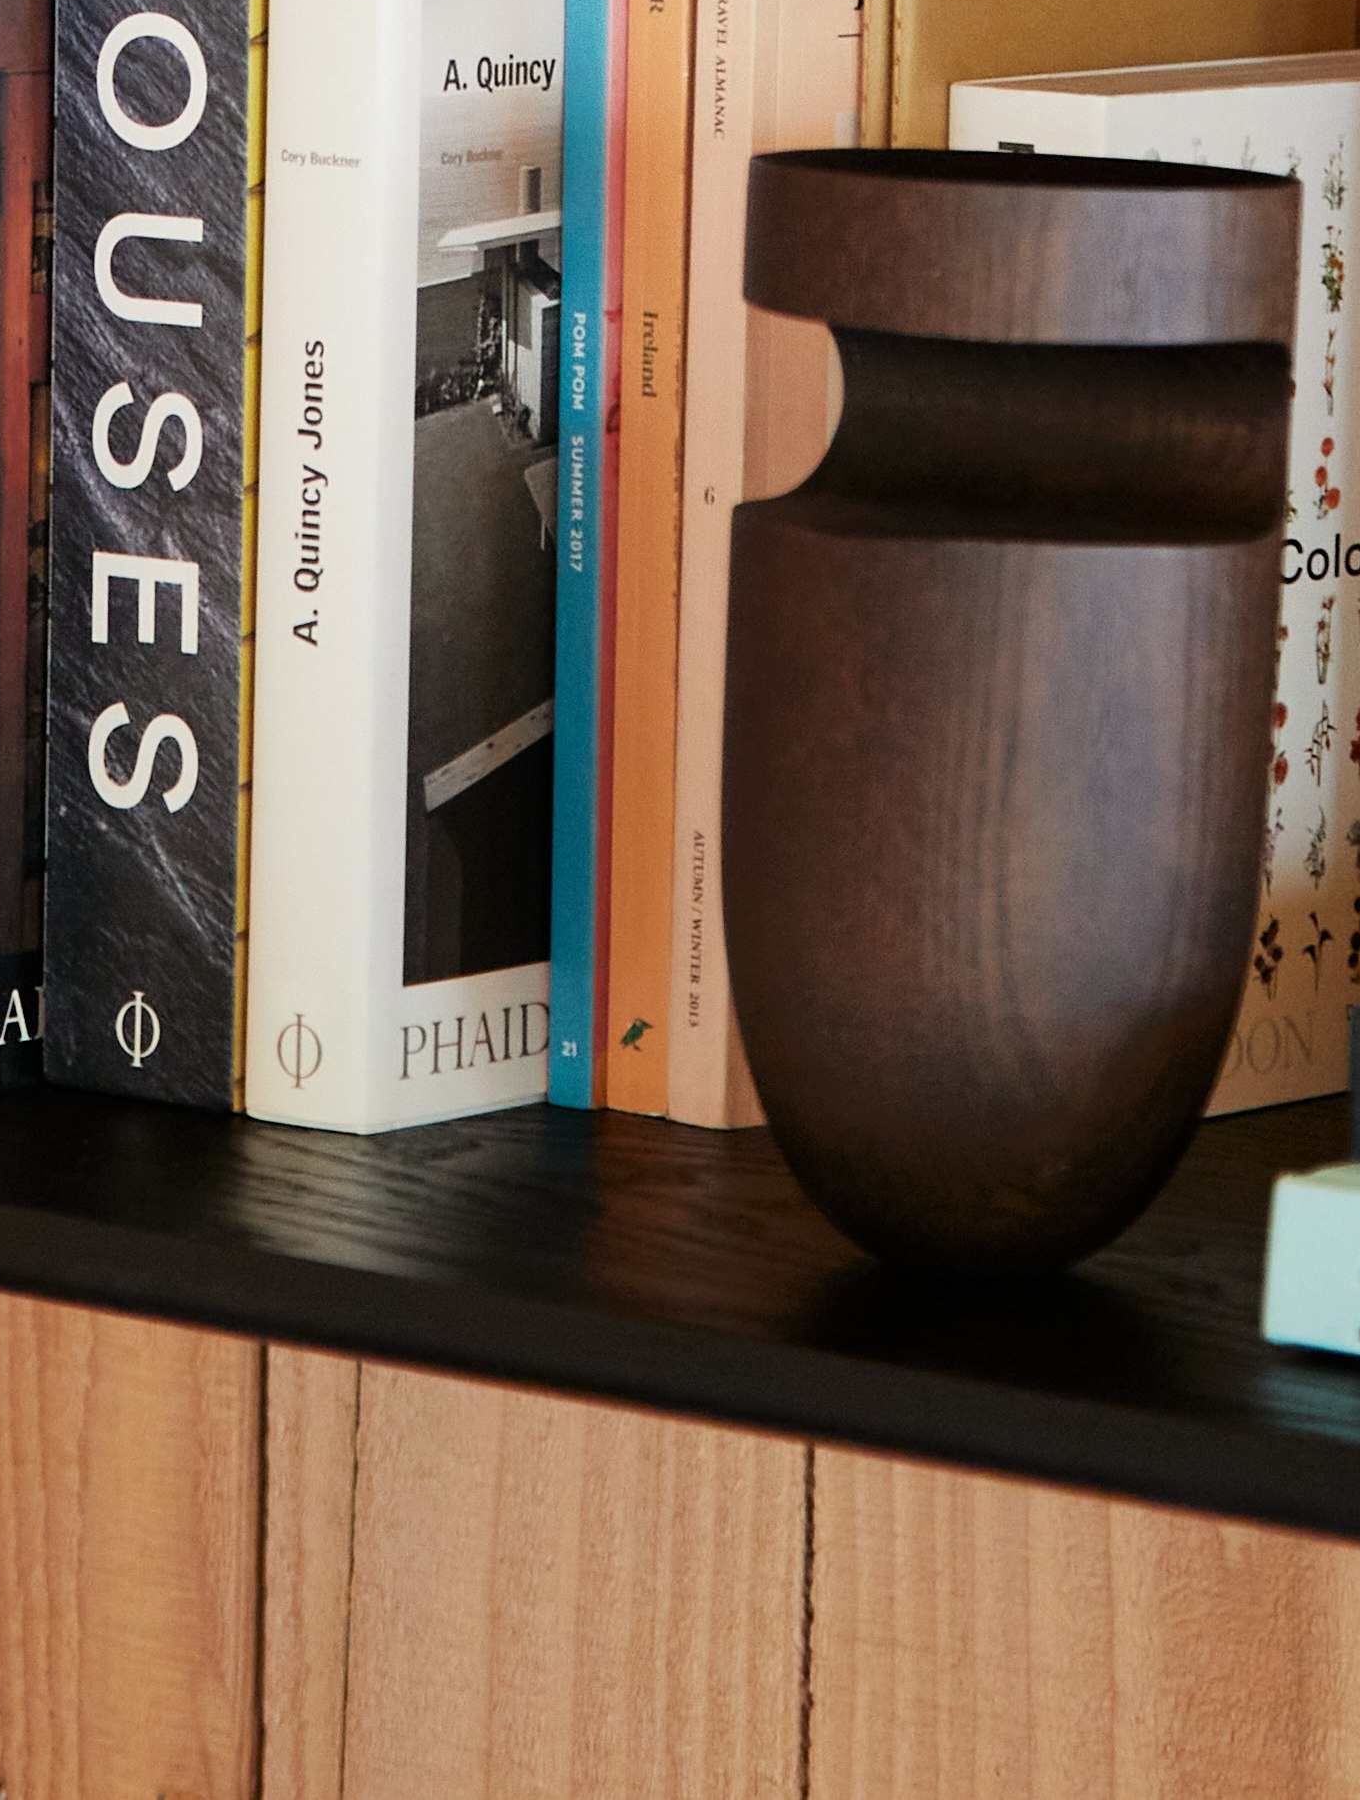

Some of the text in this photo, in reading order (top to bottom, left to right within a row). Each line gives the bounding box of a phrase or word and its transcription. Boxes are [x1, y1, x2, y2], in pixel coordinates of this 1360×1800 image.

[442, 52, 556, 92] A. Quincy
[713, 55, 726, 140] ALMANAC
[281, 150, 360, 170] Cory Buckner
[441, 148, 504, 167] Cory Buckner
[571, 313, 586, 411] POM POM
[641, 310, 658, 399] Ireland
[293, 339, 328, 646] A. Quincy Jones
[569, 435, 584, 573] SUMMER 2017
[704, 487, 715, 505] 6
[693, 831, 705, 903] AUTUMN
[690, 919, 703, 984] WINTER
[400, 1001, 550, 1080] PHAID
[562, 1041, 577, 1057] 21
